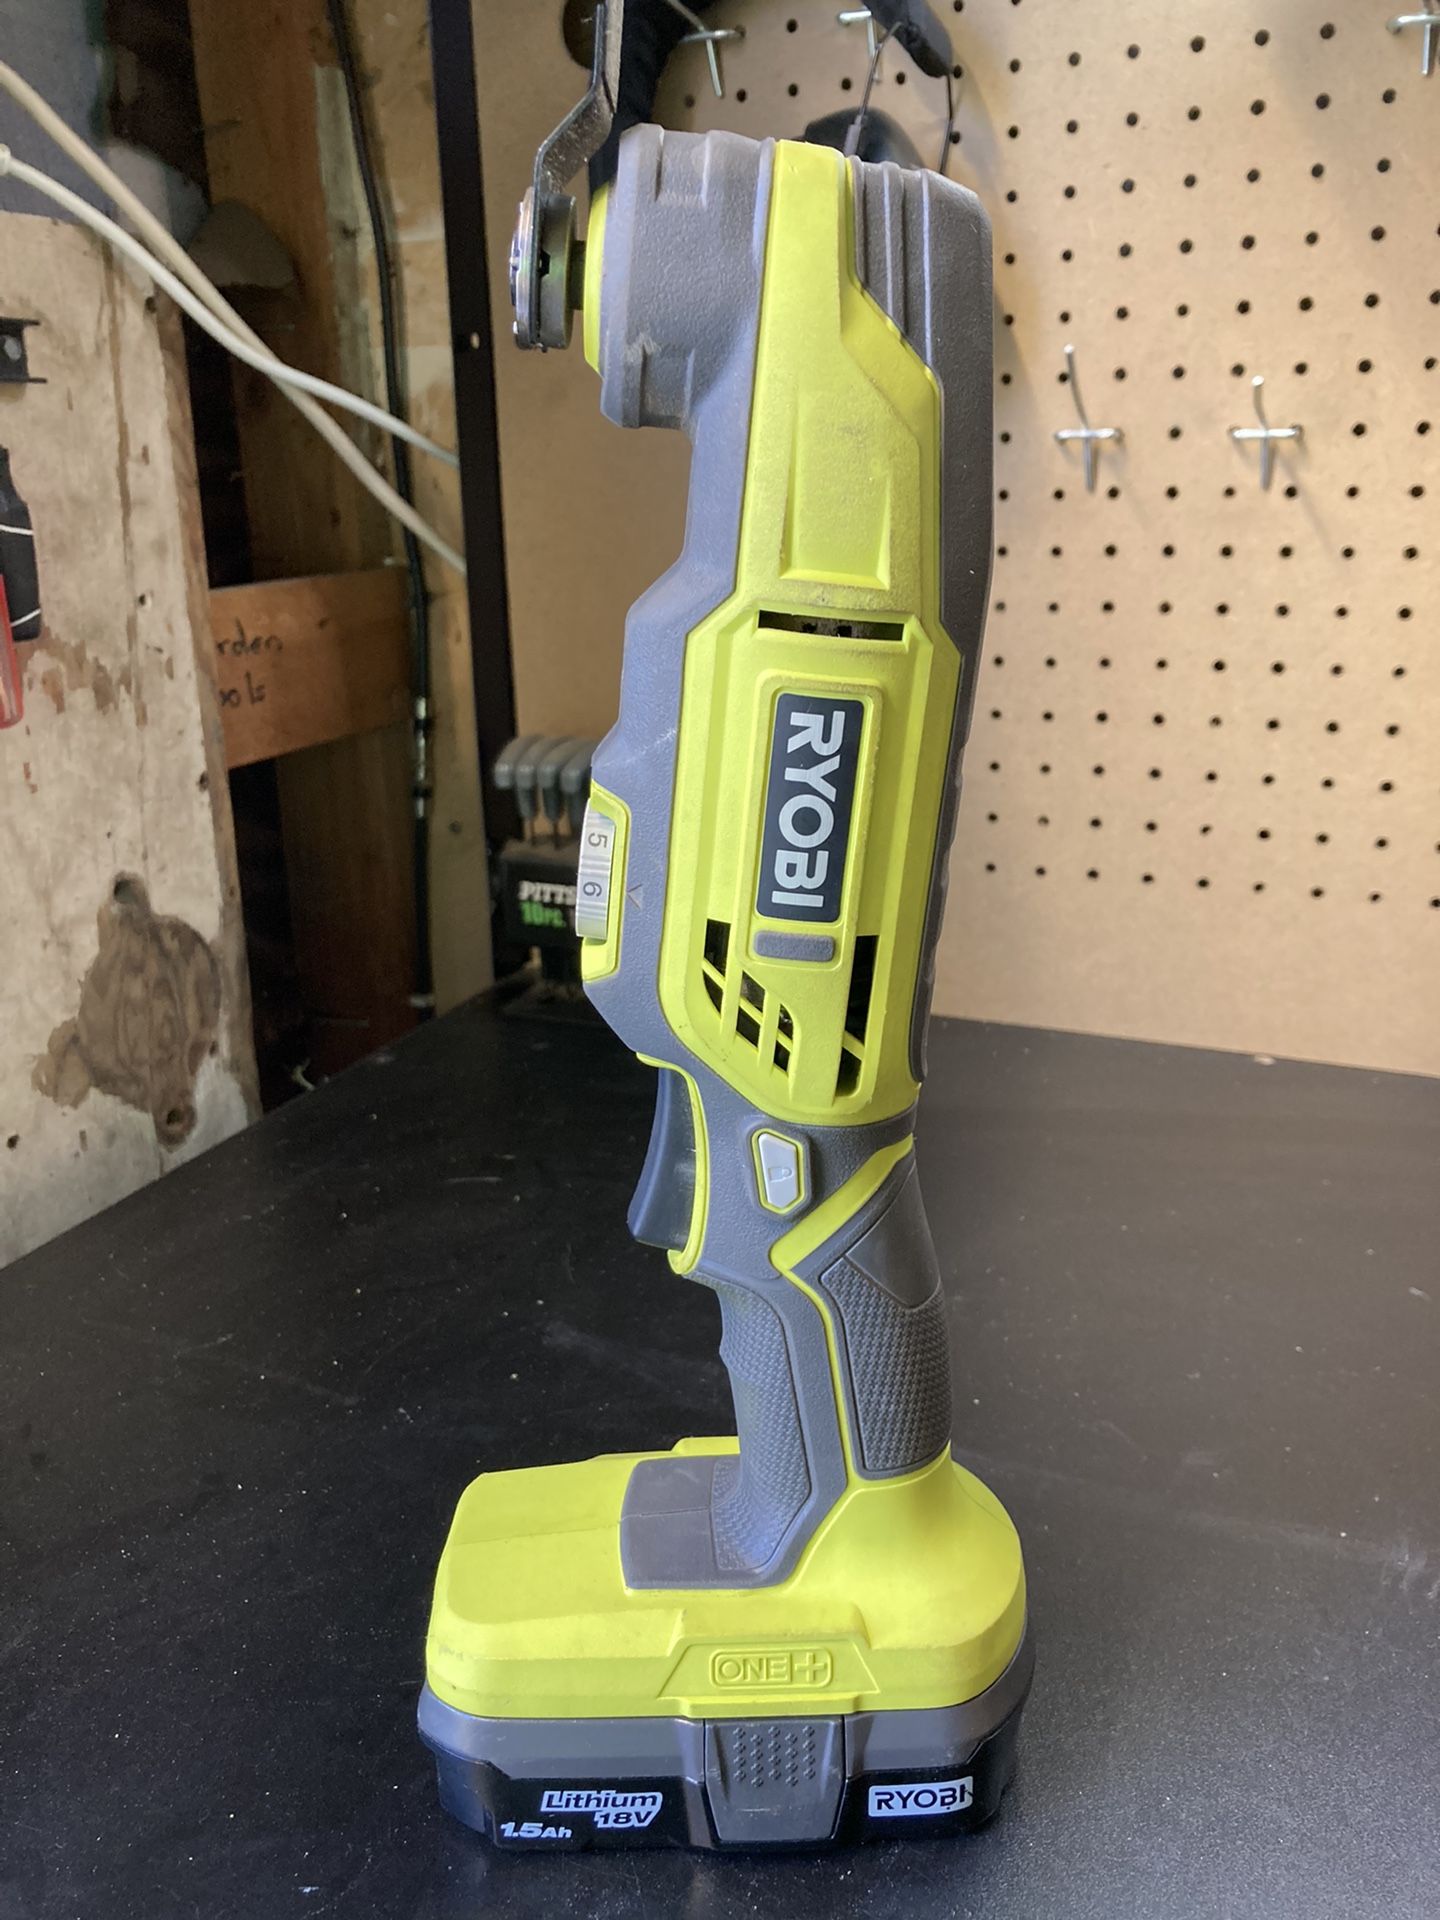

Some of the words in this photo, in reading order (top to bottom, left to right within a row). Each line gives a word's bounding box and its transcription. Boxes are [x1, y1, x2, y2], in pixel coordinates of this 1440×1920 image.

[772, 711, 845, 908] RYOBI
[588, 832, 608, 848] 5
[583, 881, 602, 897] 6
[544, 1791, 660, 1809] Lithium
[874, 1784, 967, 1811] RYOBI
[598, 1810, 653, 1826] 18V
[500, 1822, 572, 1838] 1.5Ah
